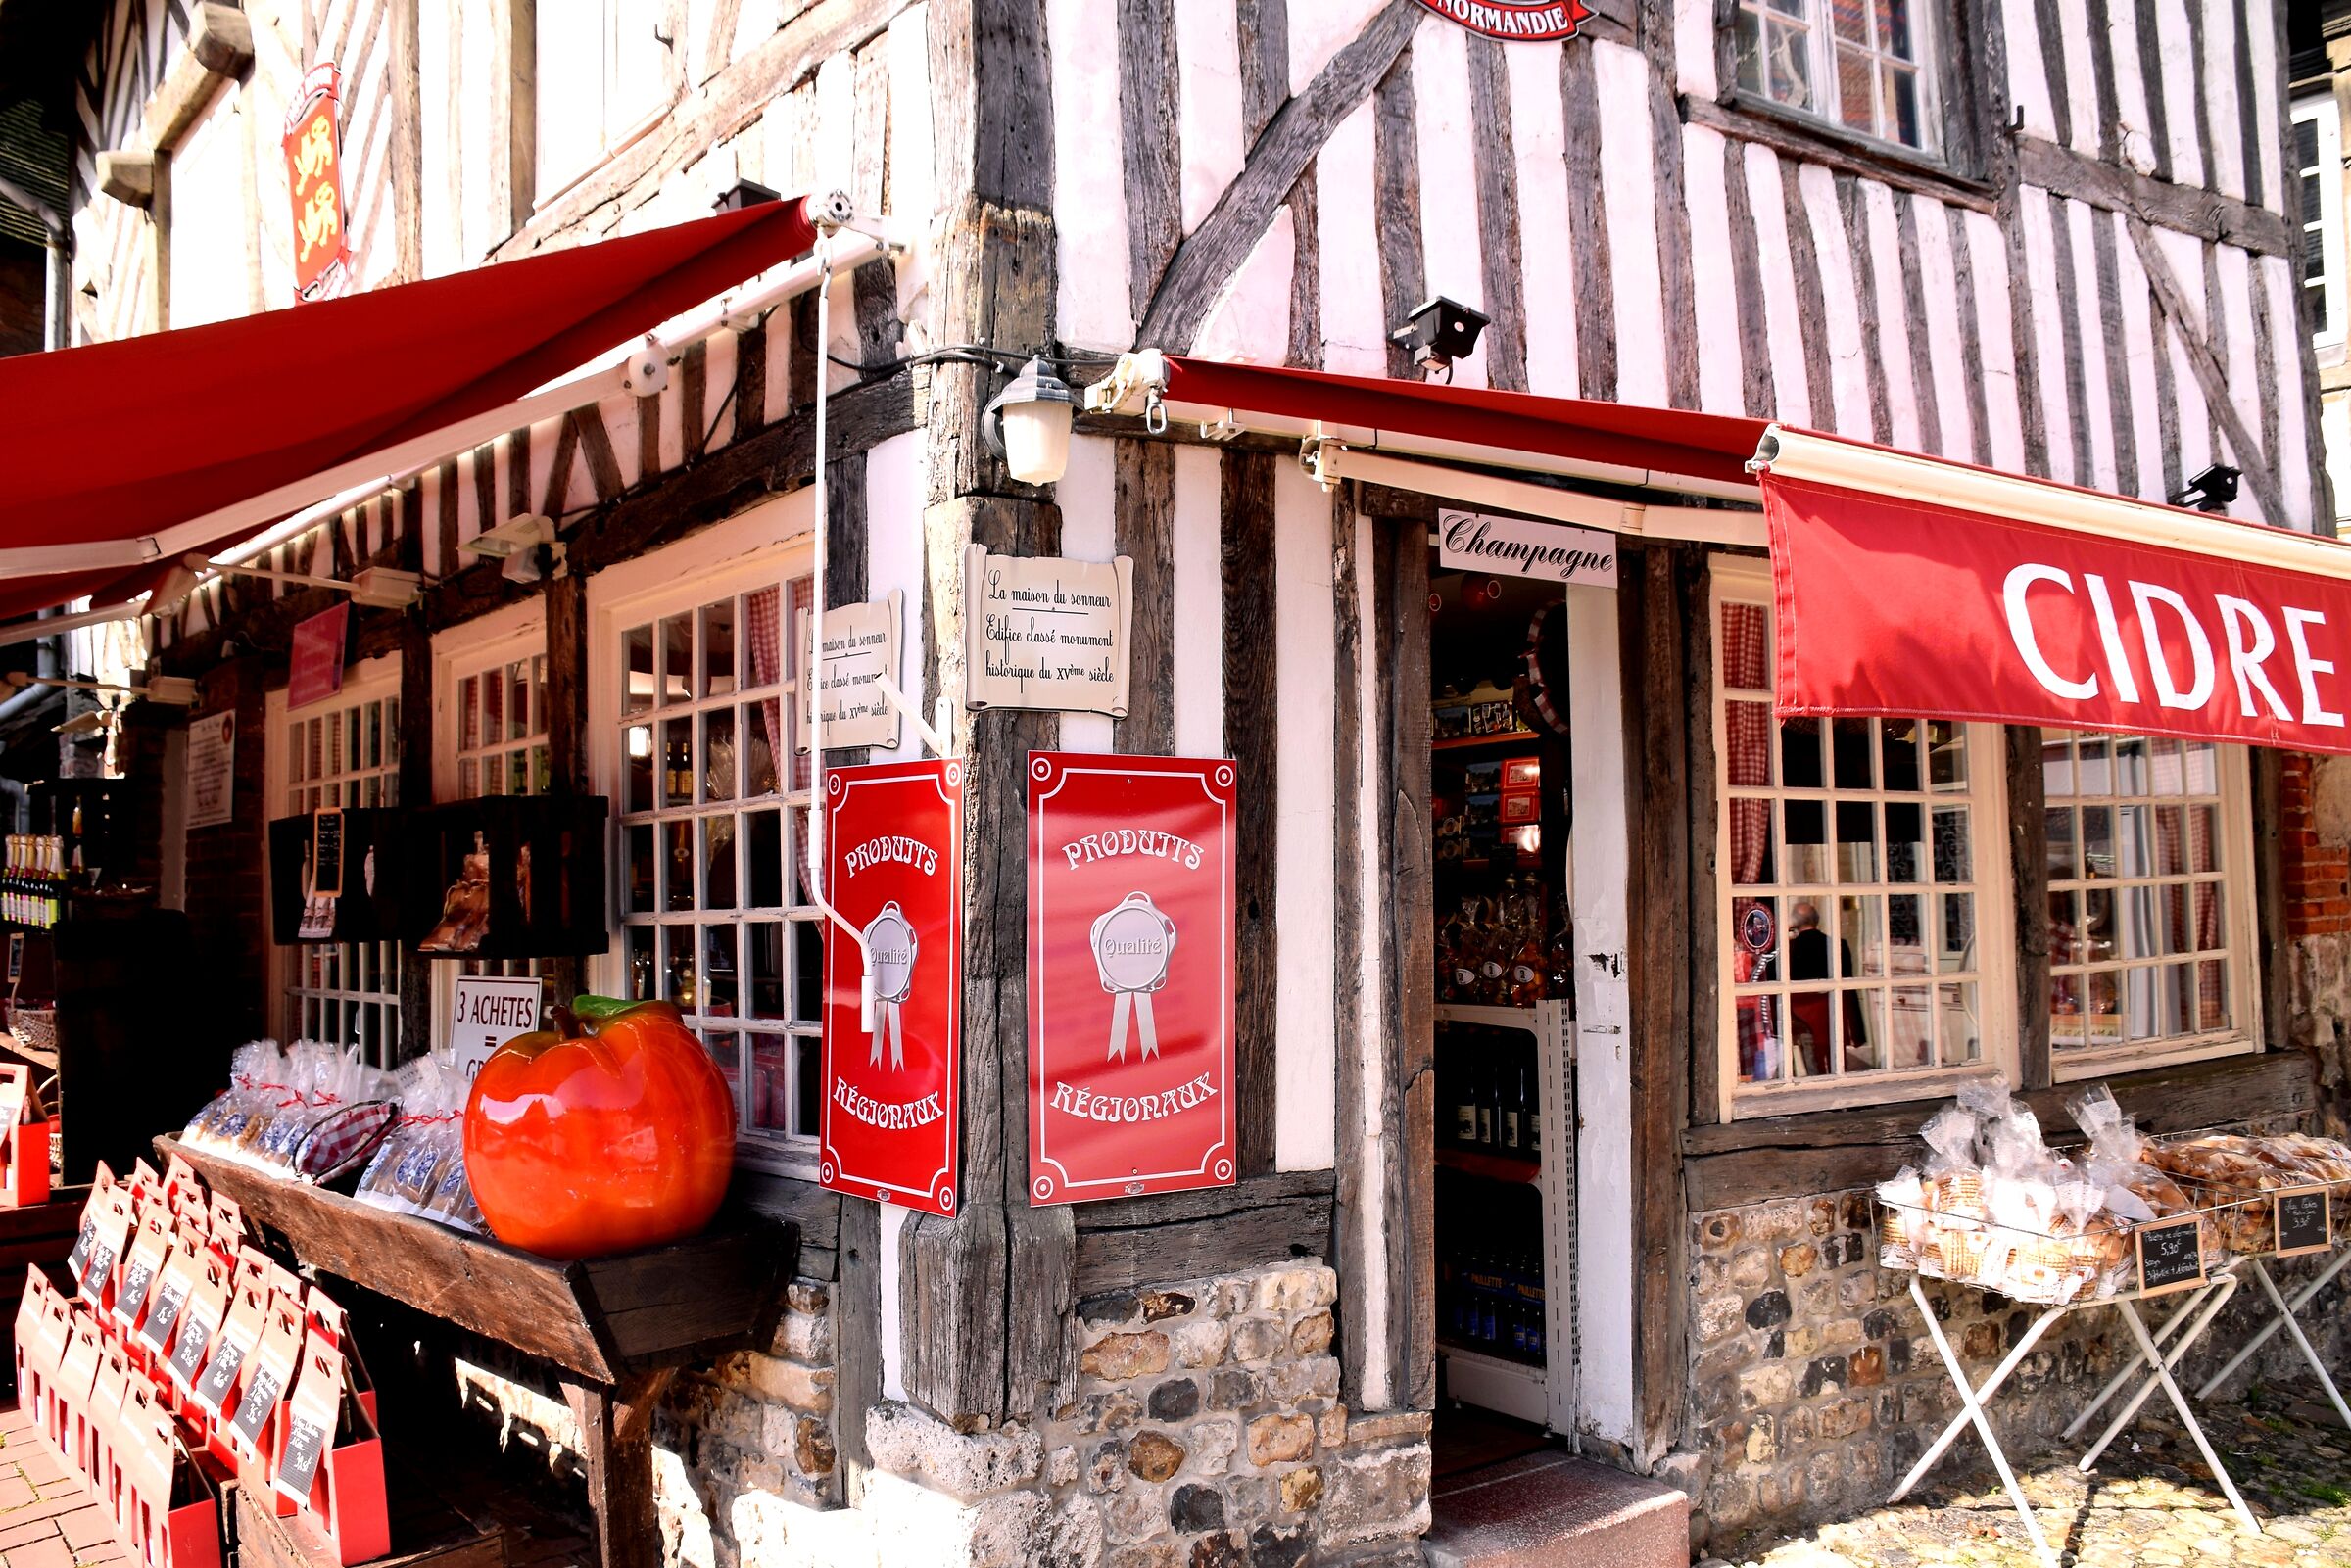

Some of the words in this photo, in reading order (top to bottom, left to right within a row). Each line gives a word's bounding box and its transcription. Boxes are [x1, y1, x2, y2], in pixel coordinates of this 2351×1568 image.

[1443, 514, 1614, 580] Champagne
[987, 569, 1007, 599] La
[1011, 588, 1049, 603] maison
[1054, 579, 1067, 605] du
[1071, 594, 1111, 608] sonneur
[848, 625, 856, 648] du
[859, 632, 886, 646] sonneur
[986, 614, 1022, 665] Edifice
[1026, 616, 1056, 643] classé
[1060, 630, 1113, 647] monument
[2003, 563, 2345, 727] CIDRE
[831, 664, 849, 689] classé
[985, 650, 1034, 693] historique
[1039, 657, 1052, 679] du
[1089, 656, 1114, 682] siècle
[839, 699, 846, 722] du
[871, 691, 888, 717] siècle
[844, 835, 938, 878] PRODUITS
[1062, 830, 1204, 870] PRODUITS
[870, 947, 908, 967] Qualité
[1105, 937, 1162, 958] Qualité
[457, 991, 466, 1022] 3
[470, 995, 533, 1028] ACHETES
[832, 1076, 944, 1129] RÉGIONAUX
[1049, 1071, 1218, 1123] RÉGIONAUX
